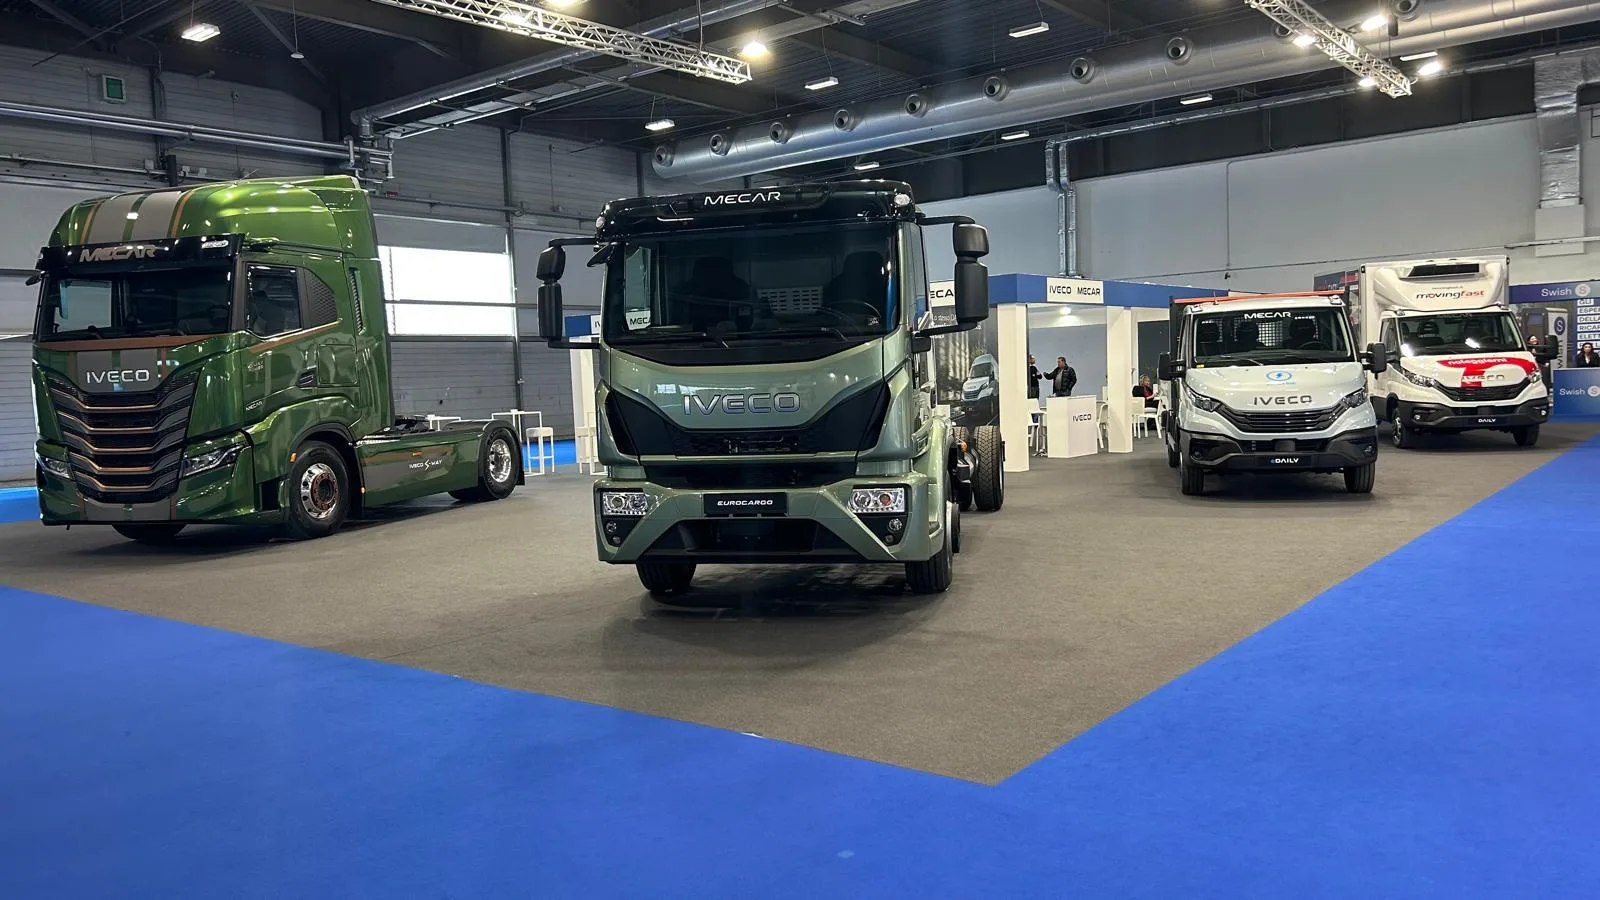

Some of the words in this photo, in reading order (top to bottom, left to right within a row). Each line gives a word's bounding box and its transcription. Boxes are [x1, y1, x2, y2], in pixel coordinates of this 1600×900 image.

[704, 191, 781, 206] MECAR
[79, 245, 157, 263] MECAR
[930, 288, 954, 299] ECA
[1050, 285, 1072, 295] IVECO
[1077, 286, 1101, 296] MECAR
[1416, 290, 1485, 299] movingfast
[1541, 287, 1572, 297] Swish
[1244, 311, 1292, 320] MECAR
[86, 369, 150, 384] IVECO
[1559, 388, 1586, 396] Swish
[683, 392, 800, 415] IVECO
[1253, 395, 1312, 406] IVECO
[1072, 413, 1092, 422] IVECO
